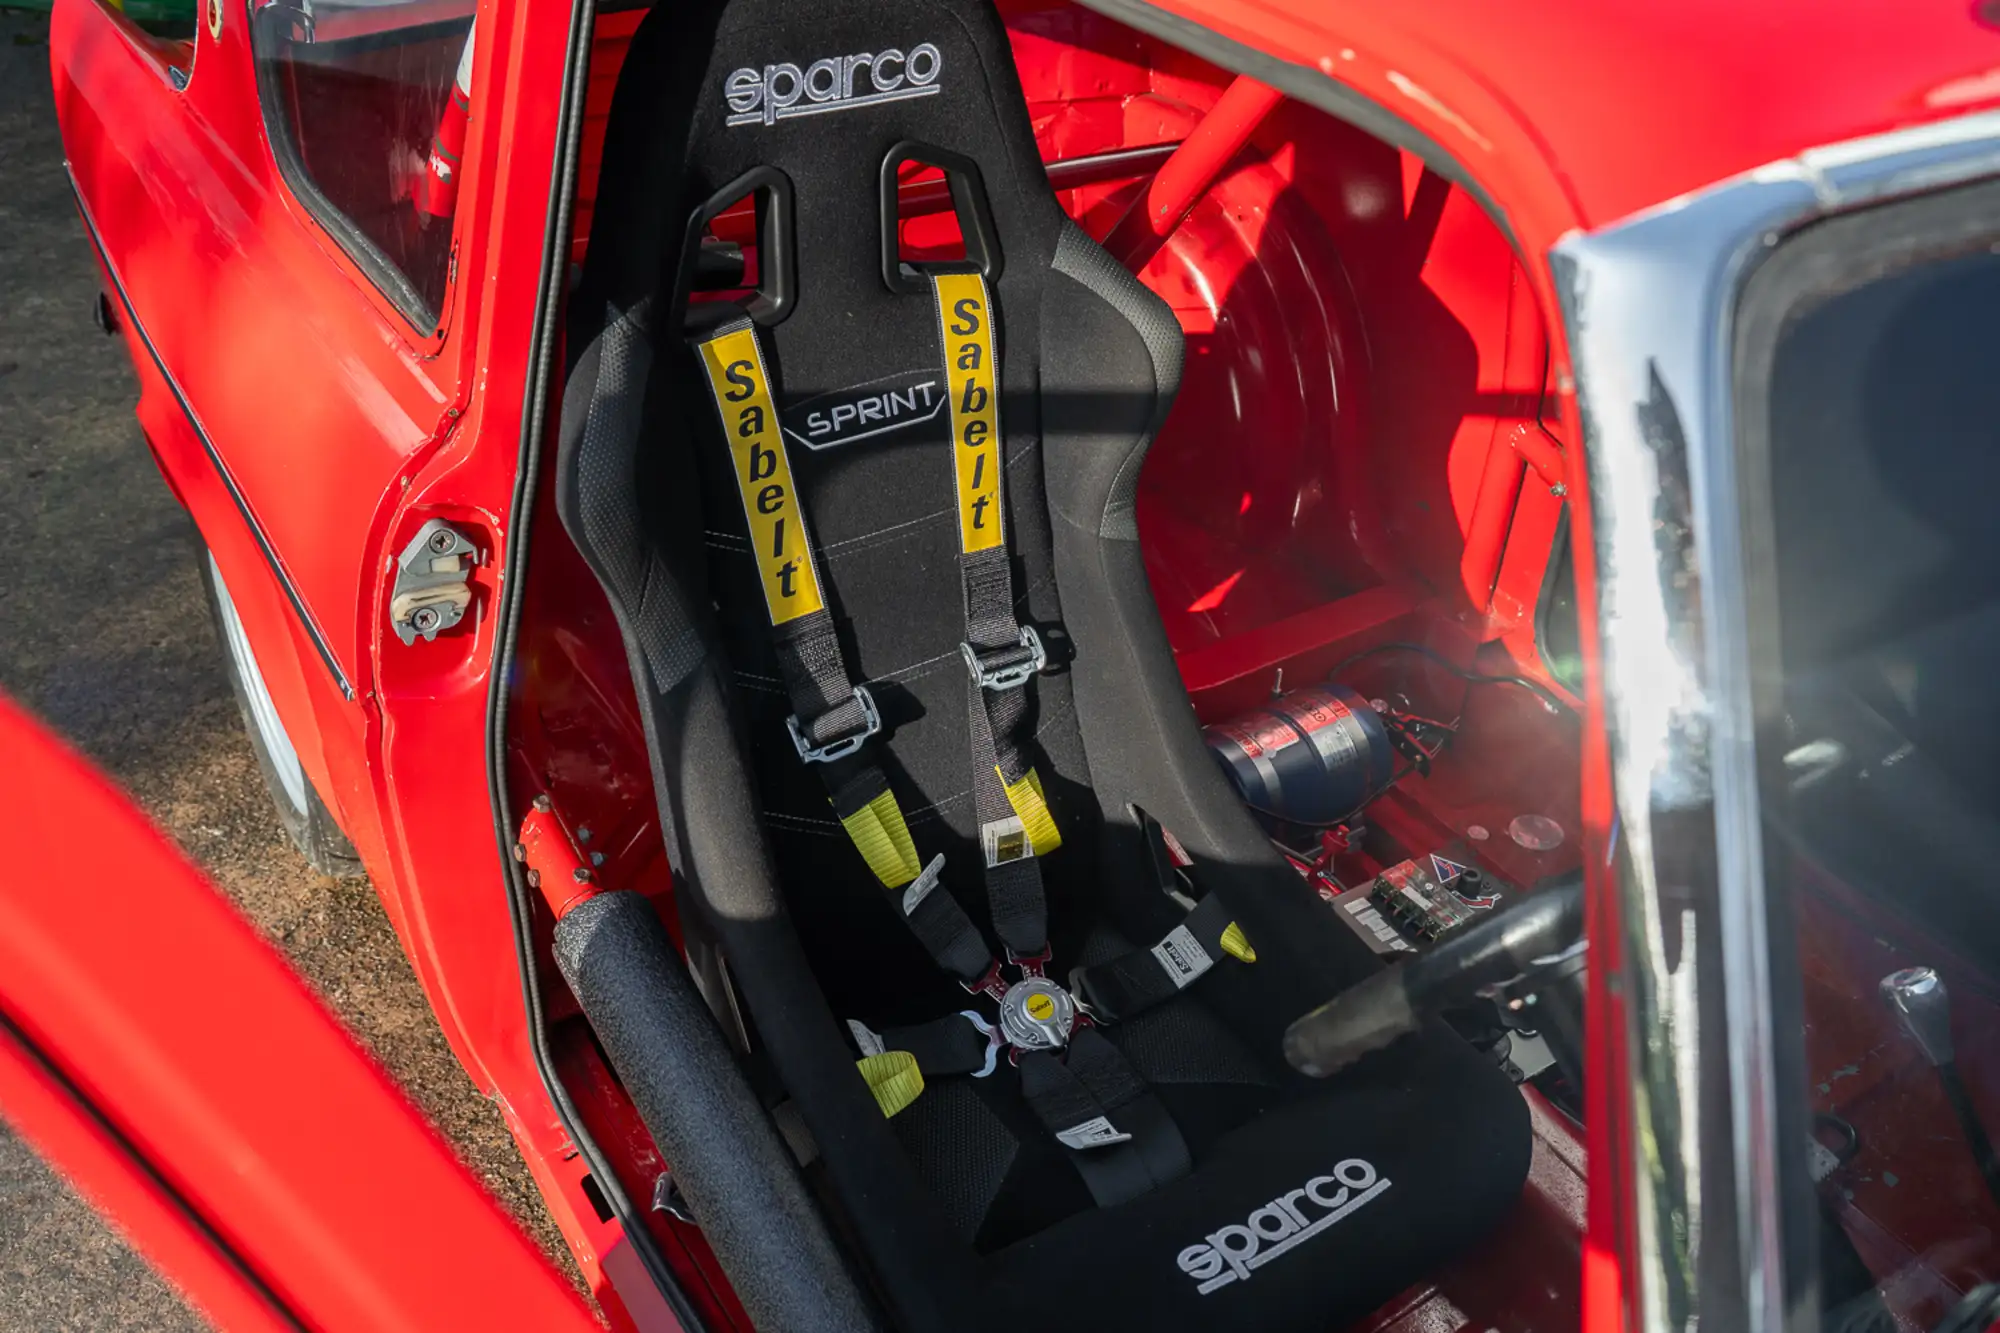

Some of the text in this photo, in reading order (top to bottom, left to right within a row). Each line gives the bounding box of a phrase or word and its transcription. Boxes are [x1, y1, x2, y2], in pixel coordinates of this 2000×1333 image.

[724, 43, 942, 127] sparco
[807, 380, 936, 437] SPRINT
[951, 298, 990, 530] Sabelt
[725, 359, 799, 598] Sabelt
[1177, 1158, 1380, 1283] sparco
